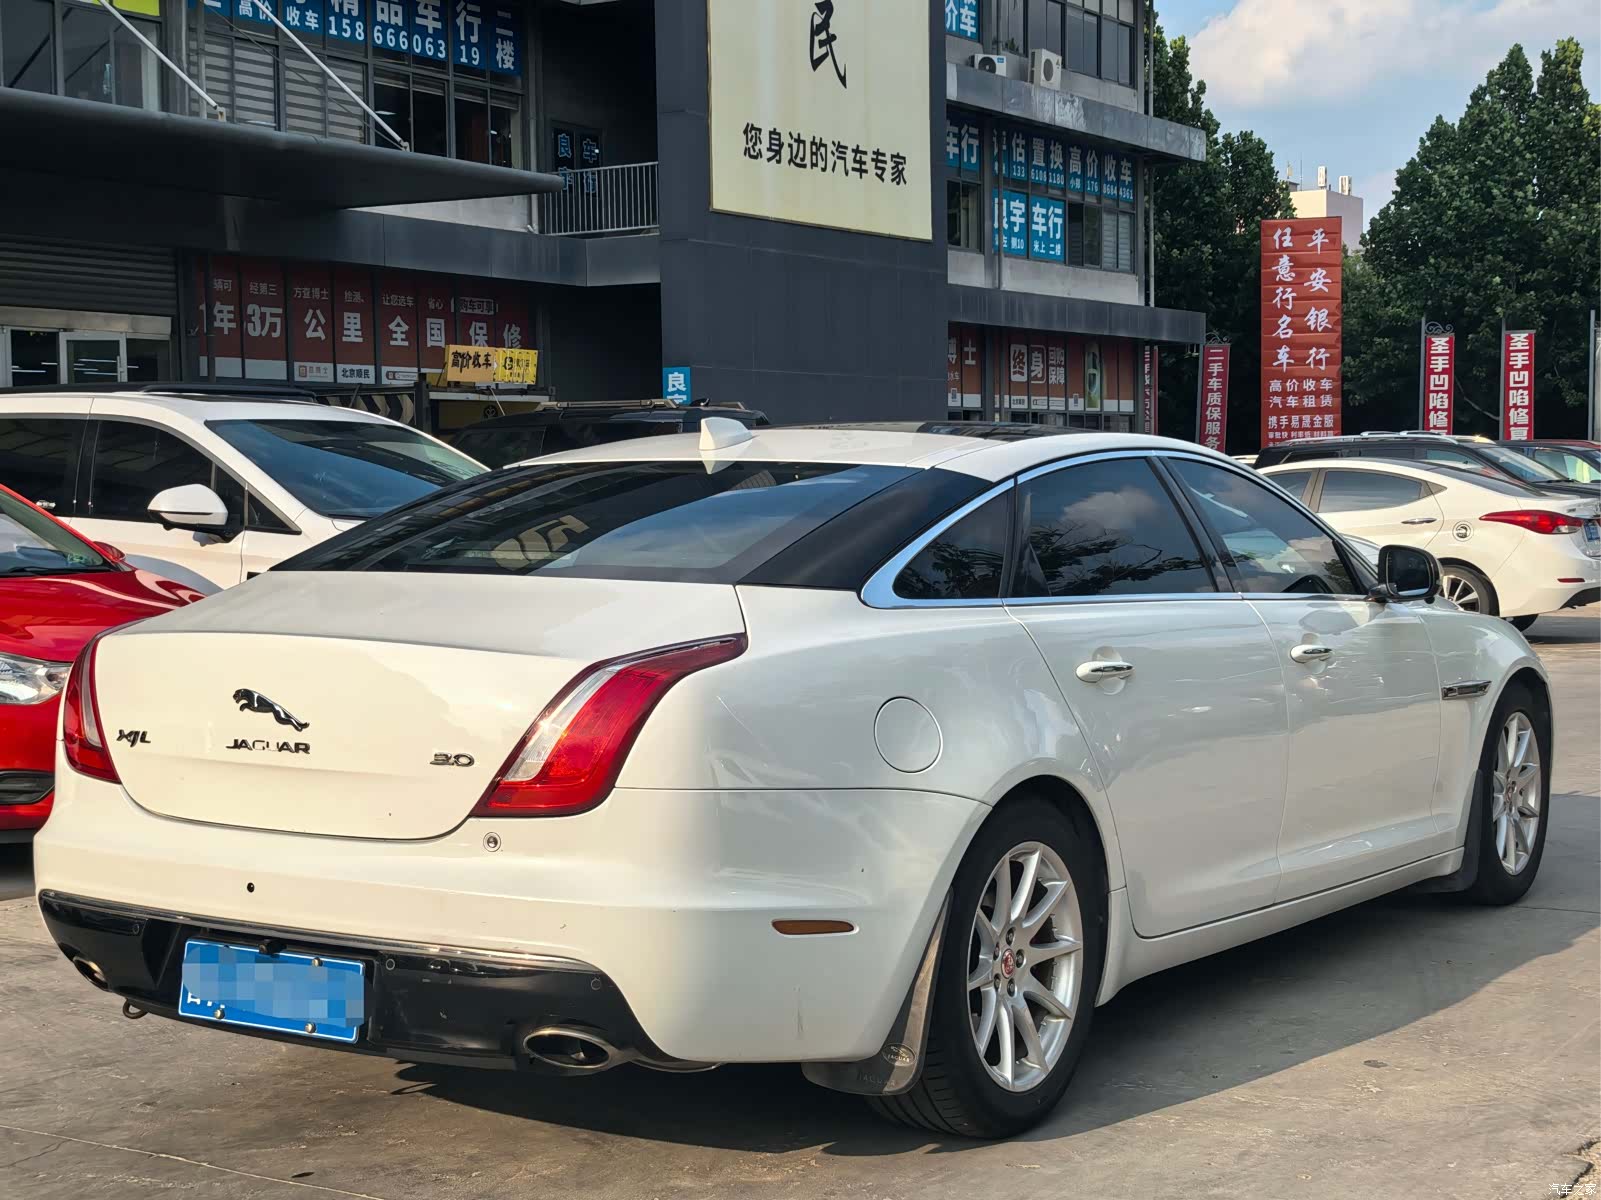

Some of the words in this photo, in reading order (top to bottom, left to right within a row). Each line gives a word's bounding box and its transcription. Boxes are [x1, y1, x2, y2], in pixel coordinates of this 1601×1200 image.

[743, 122, 907, 186] 您身边的汽车专家
[1304, 228, 1333, 371] 平安银行
[1269, 378, 1333, 392] 高价收车
[1205, 349, 1225, 450] 二手车质保服务
[1269, 394, 1333, 408] 汽车租赁
[116, 729, 151, 748] XJL
[225, 738, 311, 754] JAGUAR
